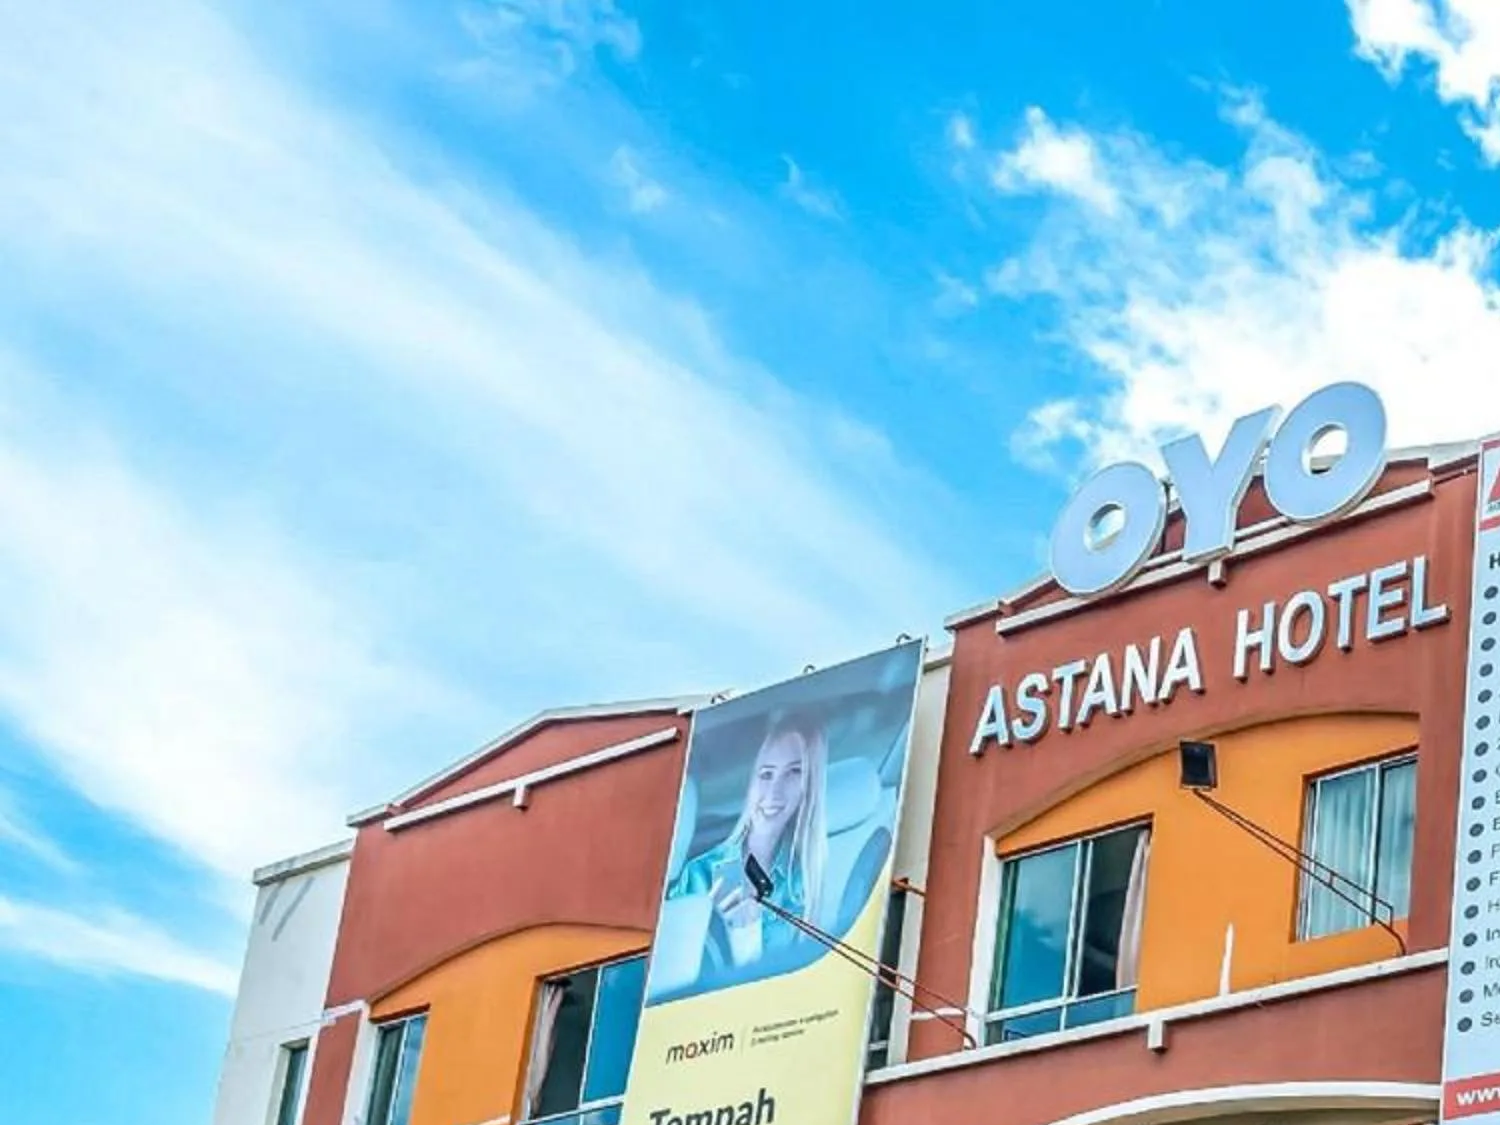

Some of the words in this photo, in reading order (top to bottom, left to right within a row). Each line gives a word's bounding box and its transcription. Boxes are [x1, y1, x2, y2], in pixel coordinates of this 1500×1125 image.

[1049, 381, 1388, 598] OYO
[968, 626, 1206, 757] ASTANA
[1233, 555, 1451, 682] HOTEL
